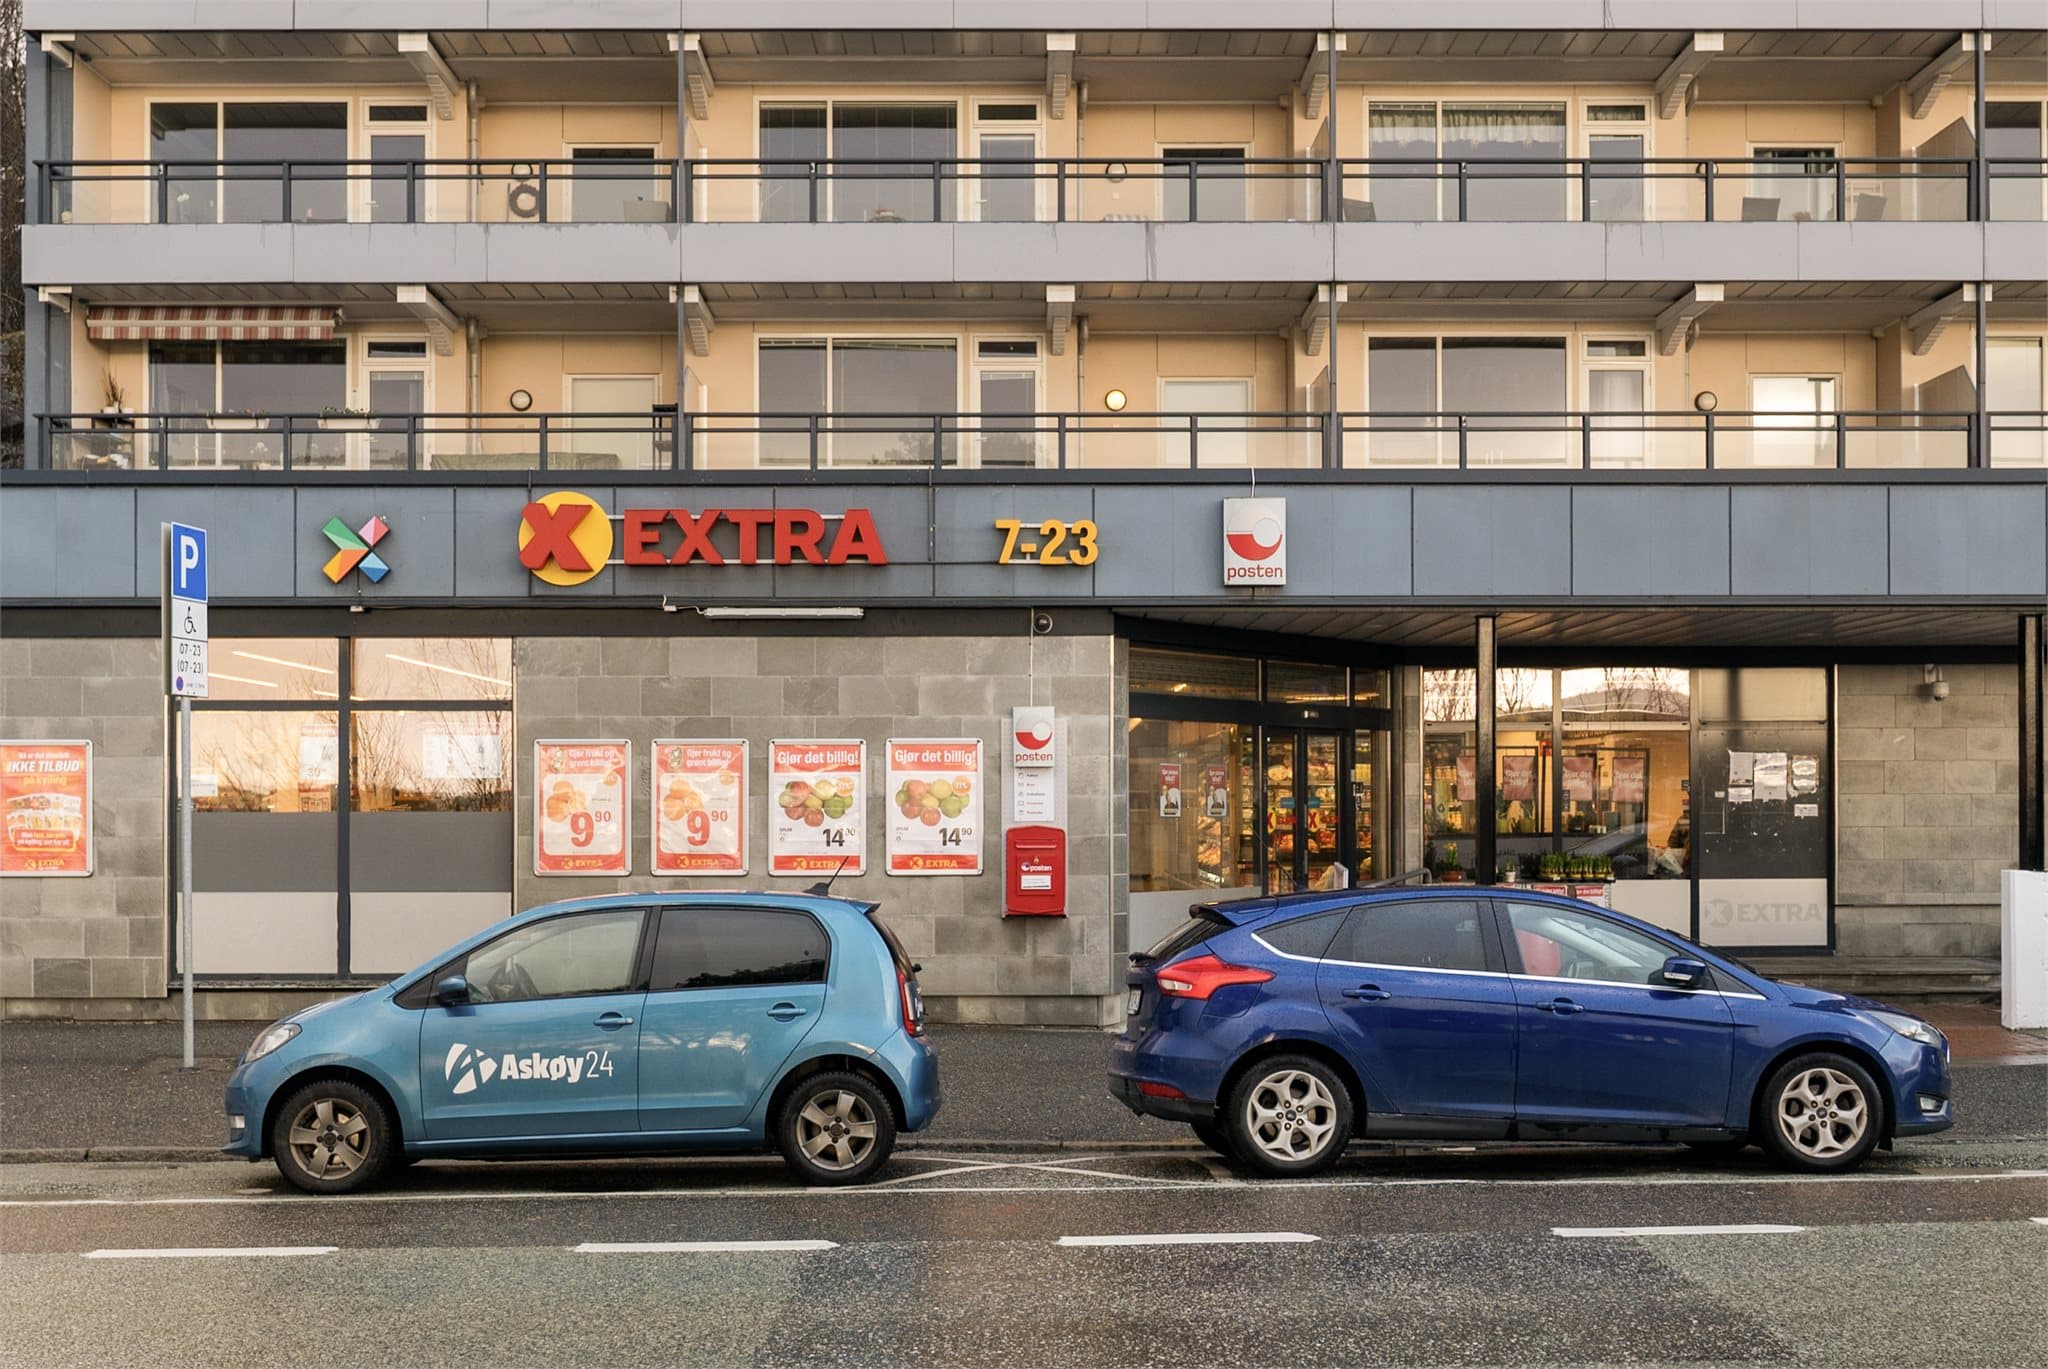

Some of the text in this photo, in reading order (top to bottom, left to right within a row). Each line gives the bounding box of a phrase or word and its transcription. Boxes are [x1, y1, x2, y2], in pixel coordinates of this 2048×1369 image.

[624, 509, 889, 565] EXTRA
[995, 519, 1099, 566] 7-23
[180, 534, 199, 589] P
[1227, 564, 1283, 581] posten
[179, 643, 202, 657] 07-23
[177, 660, 204, 675] (07-23)
[777, 751, 859, 766] Gjør det billig!
[894, 750, 977, 766] Gjør det billig!
[1015, 752, 1053, 763] posten
[8, 760, 80, 773] IKKE TILBUD
[570, 810, 612, 848] 9 90
[687, 810, 729, 846] 9 90
[823, 828, 845, 847] 14
[939, 827, 973, 847] 14 90
[809, 860, 842, 869] EXTRA
[925, 859, 959, 868] EXTRA
[1029, 865, 1052, 873] posten
[1737, 903, 1824, 923] EXTRA
